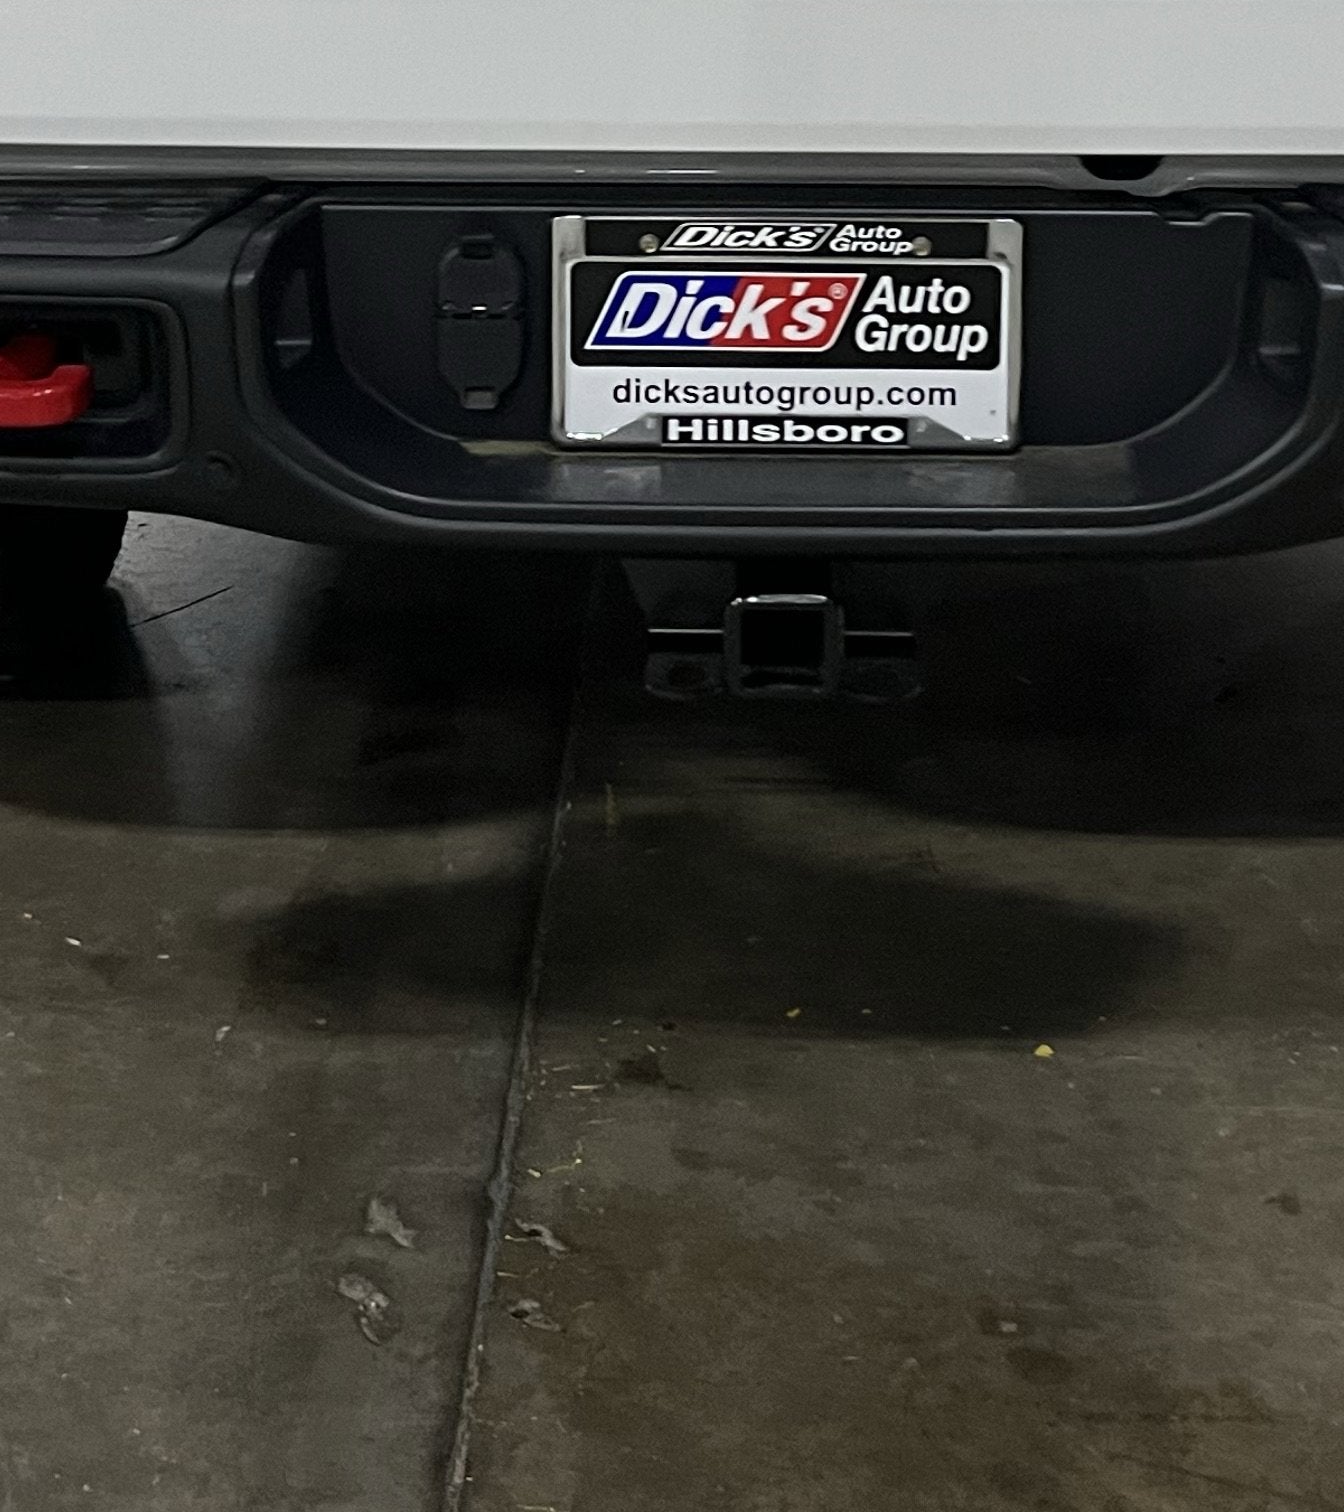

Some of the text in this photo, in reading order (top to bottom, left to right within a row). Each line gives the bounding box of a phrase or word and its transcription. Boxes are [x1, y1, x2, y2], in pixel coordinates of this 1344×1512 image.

[835, 224, 903, 239] Auto
[828, 238, 914, 256] Group
[863, 275, 972, 315] Auto
[856, 316, 989, 362] Group
[612, 378, 958, 410] dicksautogroup.com
[666, 419, 906, 444] Hillsboro
